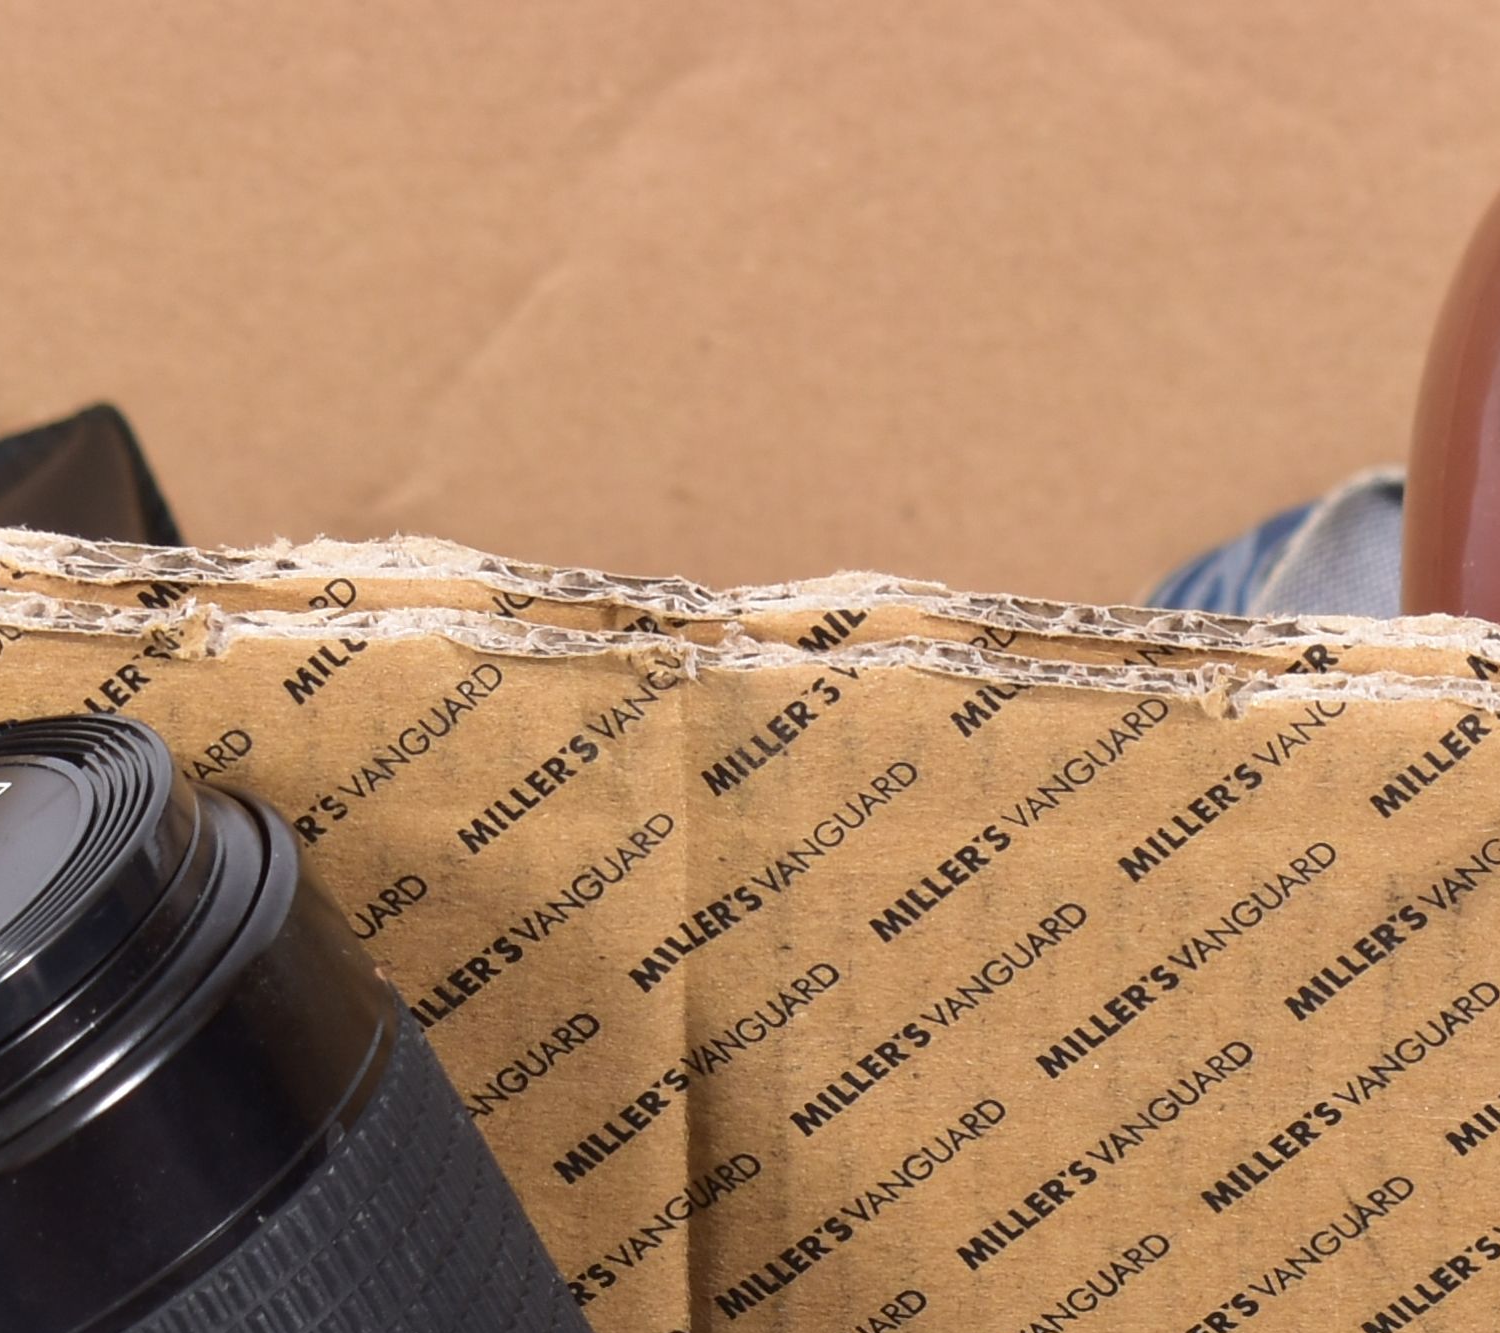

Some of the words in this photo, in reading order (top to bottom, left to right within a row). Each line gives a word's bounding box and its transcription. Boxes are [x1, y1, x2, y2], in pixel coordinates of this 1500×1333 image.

[627, 885, 763, 993] MILLER'S
[750, 762, 918, 893] VANGUARD
[1035, 964, 1180, 1079] MILLER'S
[1167, 842, 1336, 970] VANGUARD
[789, 1022, 931, 1137] MILLER'S
[919, 903, 1087, 1027] VANGUARD
[1200, 1101, 1342, 1214] MILLER'S
[1332, 982, 1500, 1105] VANGUARD
[713, 1216, 853, 1321] MILLER'S
[839, 1099, 1006, 1222] VANGUARD
[956, 1160, 1098, 1271] MILLER'S
[1085, 1041, 1253, 1165] VANGUARD
